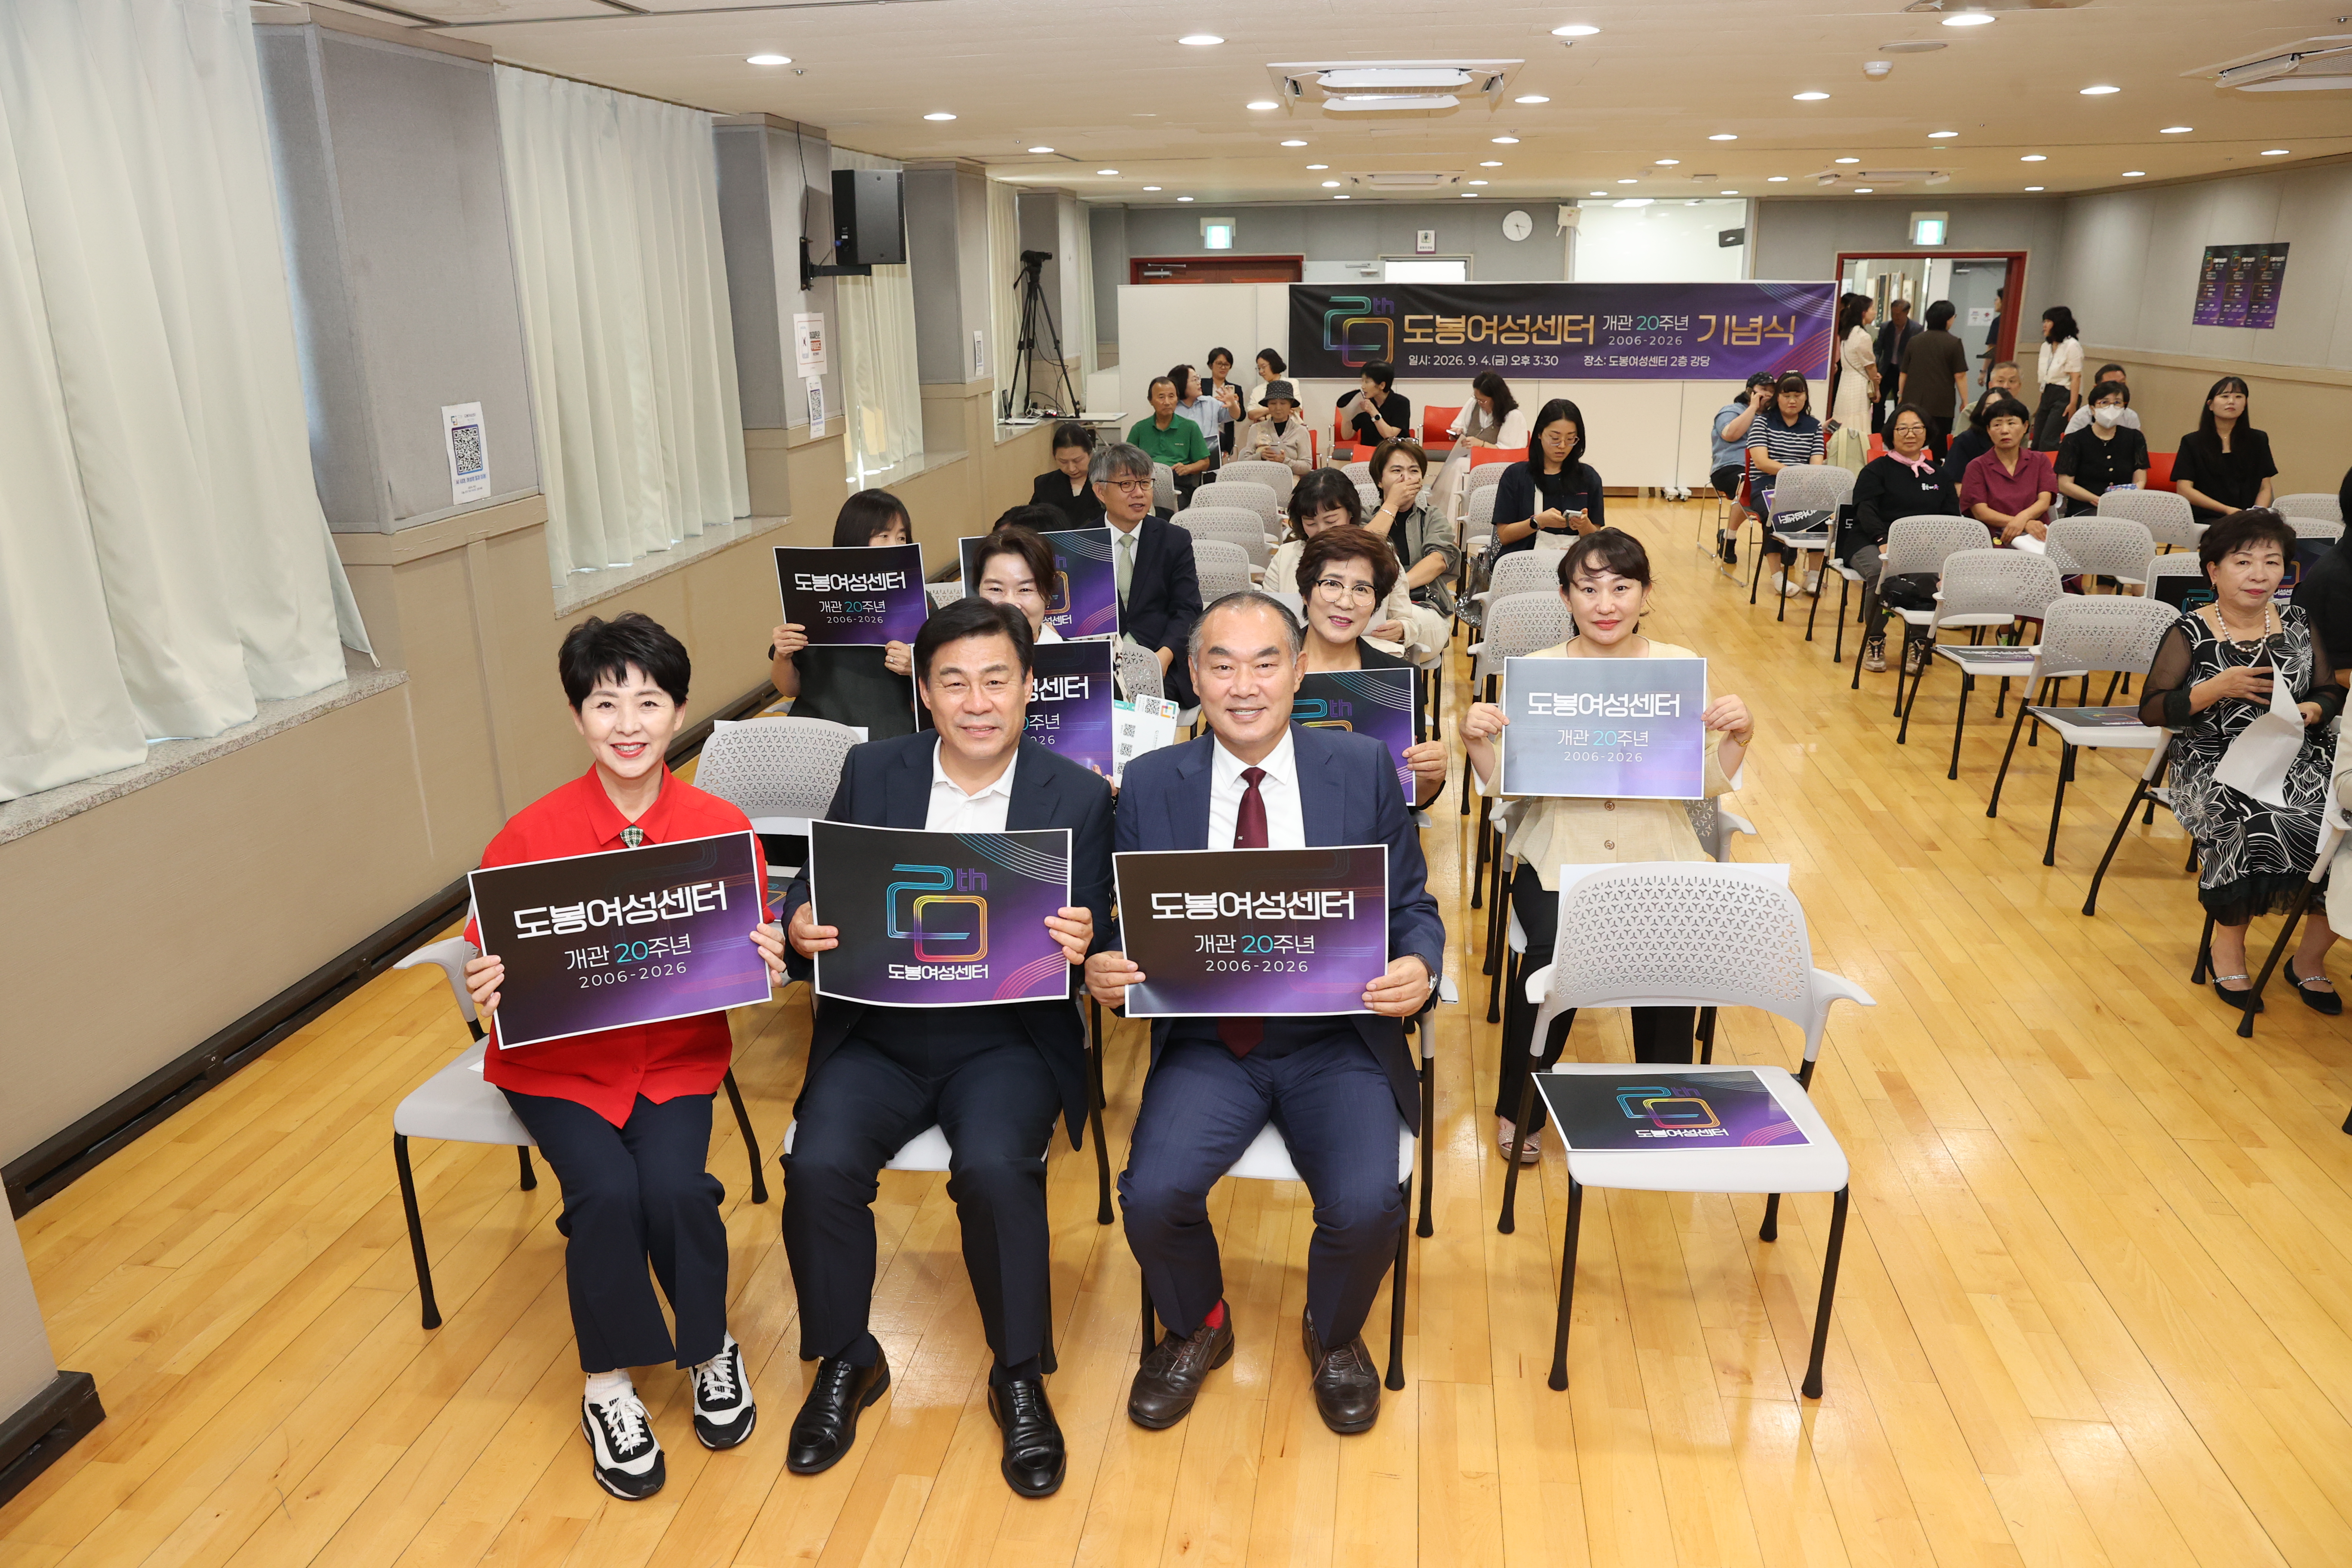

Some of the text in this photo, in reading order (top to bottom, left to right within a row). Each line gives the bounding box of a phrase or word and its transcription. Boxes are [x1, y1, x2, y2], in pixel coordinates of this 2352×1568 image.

[1403, 315, 1595, 345] 도봉여성센터
[1602, 315, 1689, 331] 개관 20주년
[1697, 315, 1796, 345] 기념식
[1608, 336, 1682, 346] 2006-2026
[1409, 355, 1430, 366] 일시:
[1433, 355, 1465, 366] 2026.
[1468, 355, 1479, 366] 9.
[1511, 355, 1531, 366] 오후
[1533, 355, 1559, 366] 3:30
[1583, 355, 1711, 367] 장소: 도봉여성센터 2층 강당
[794, 571, 906, 592] 도봉여성센터
[819, 600, 886, 613] 개관 20주년
[827, 616, 883, 624] 2006-2026
[1527, 691, 1680, 719] 도봉여성센터
[1556, 729, 1649, 748] 개관 20주년
[1563, 750, 1643, 763] 2006-2026
[513, 880, 729, 940] 도봉여성센터
[1151, 891, 1355, 920] 도봉여성센터
[564, 933, 692, 971] 개관 20주년
[1194, 934, 1316, 955] 개관 20주년
[579, 961, 687, 989] 2006-2026
[888, 963, 989, 982] 도봉여성센터
[1205, 960, 1309, 973] 2006-2026
[1635, 1128, 1729, 1138] 도봉여성센터
